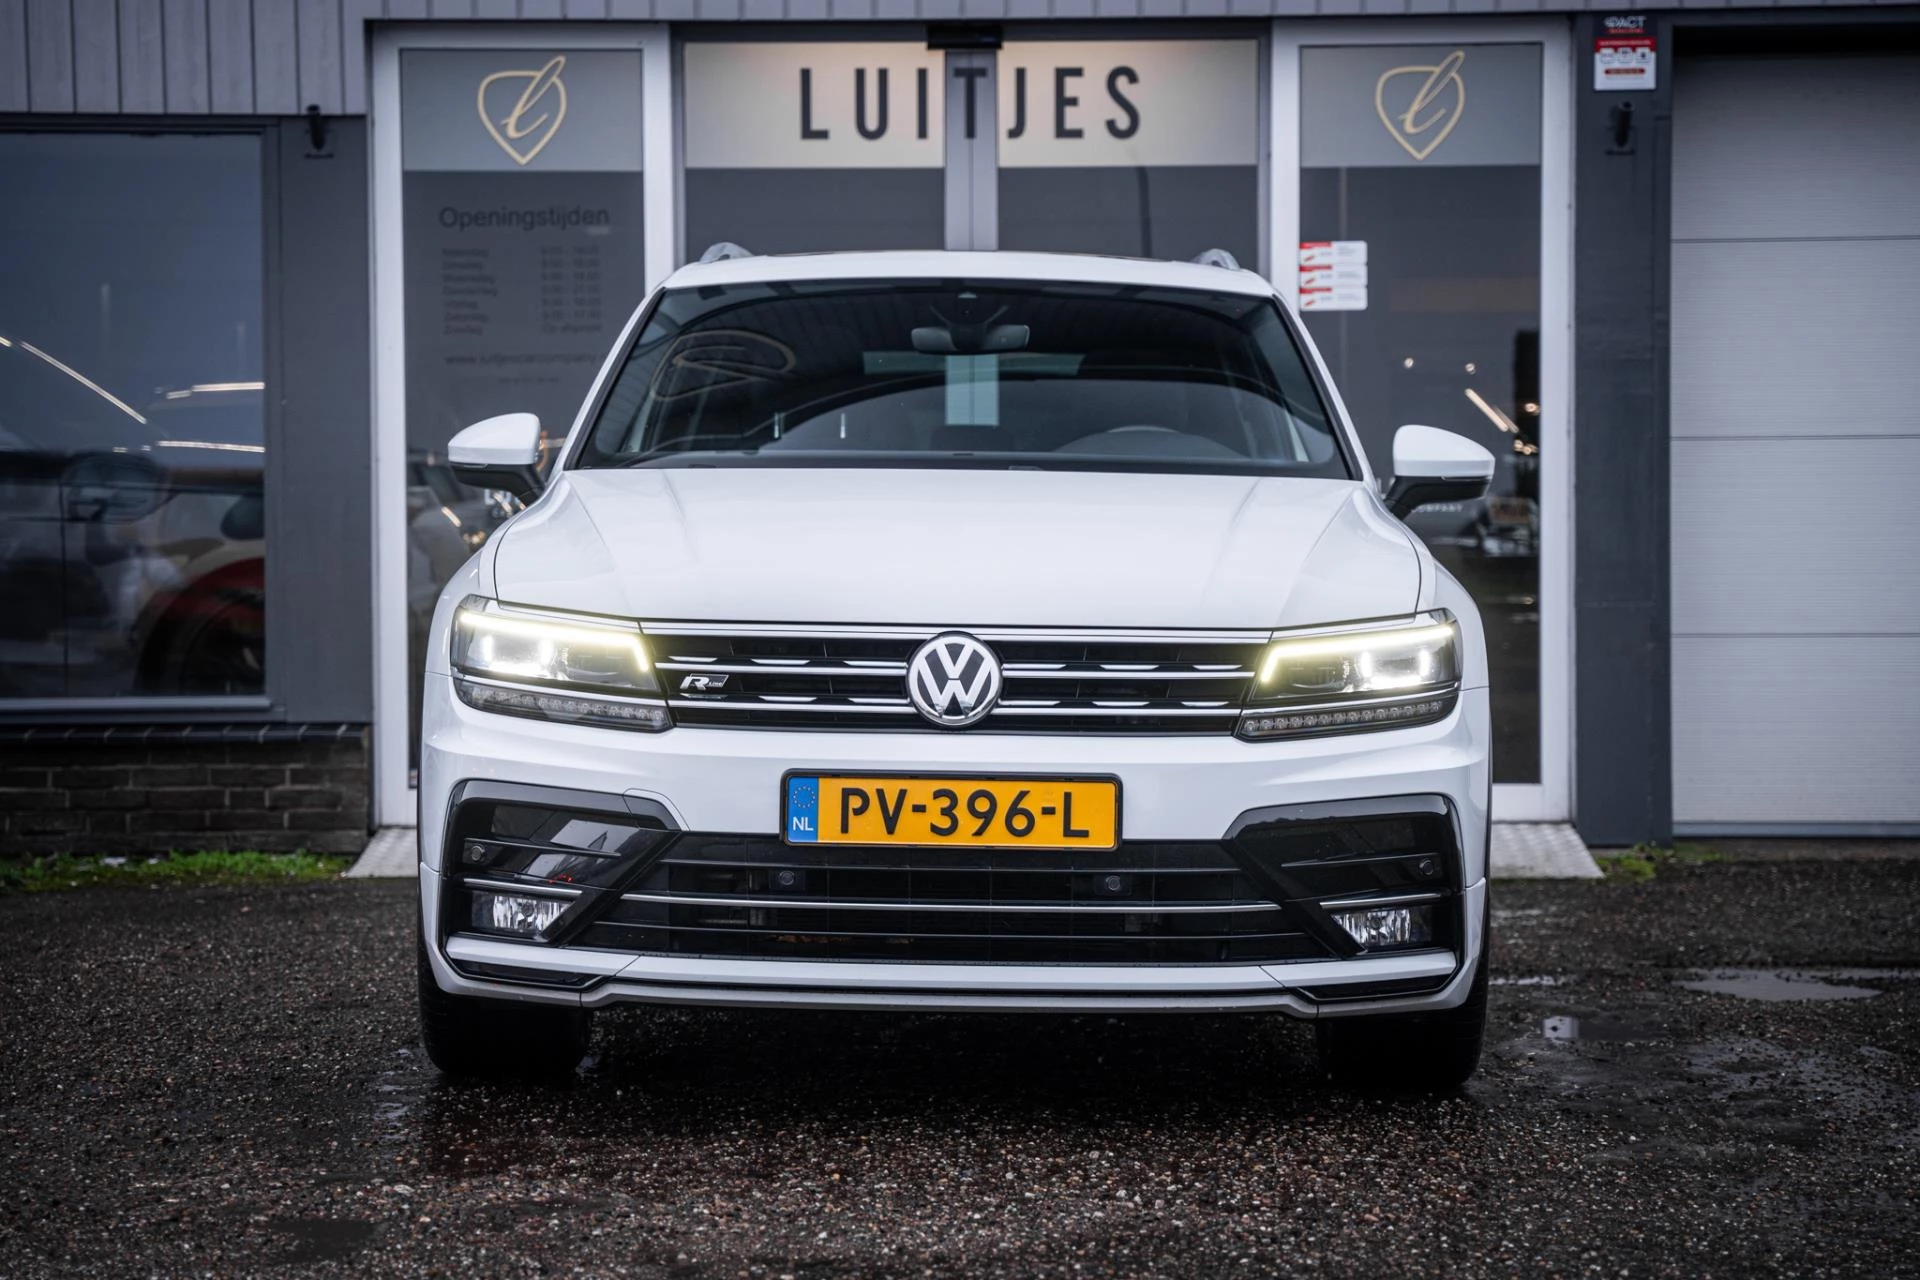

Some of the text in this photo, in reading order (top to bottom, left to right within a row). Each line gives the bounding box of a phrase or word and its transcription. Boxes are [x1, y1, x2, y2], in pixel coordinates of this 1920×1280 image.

[799, 65, 1141, 140] LUITJES
[439, 206, 610, 231] Openingstijden
[791, 816, 814, 832] NL
[840, 786, 1091, 838] PV-396-L
